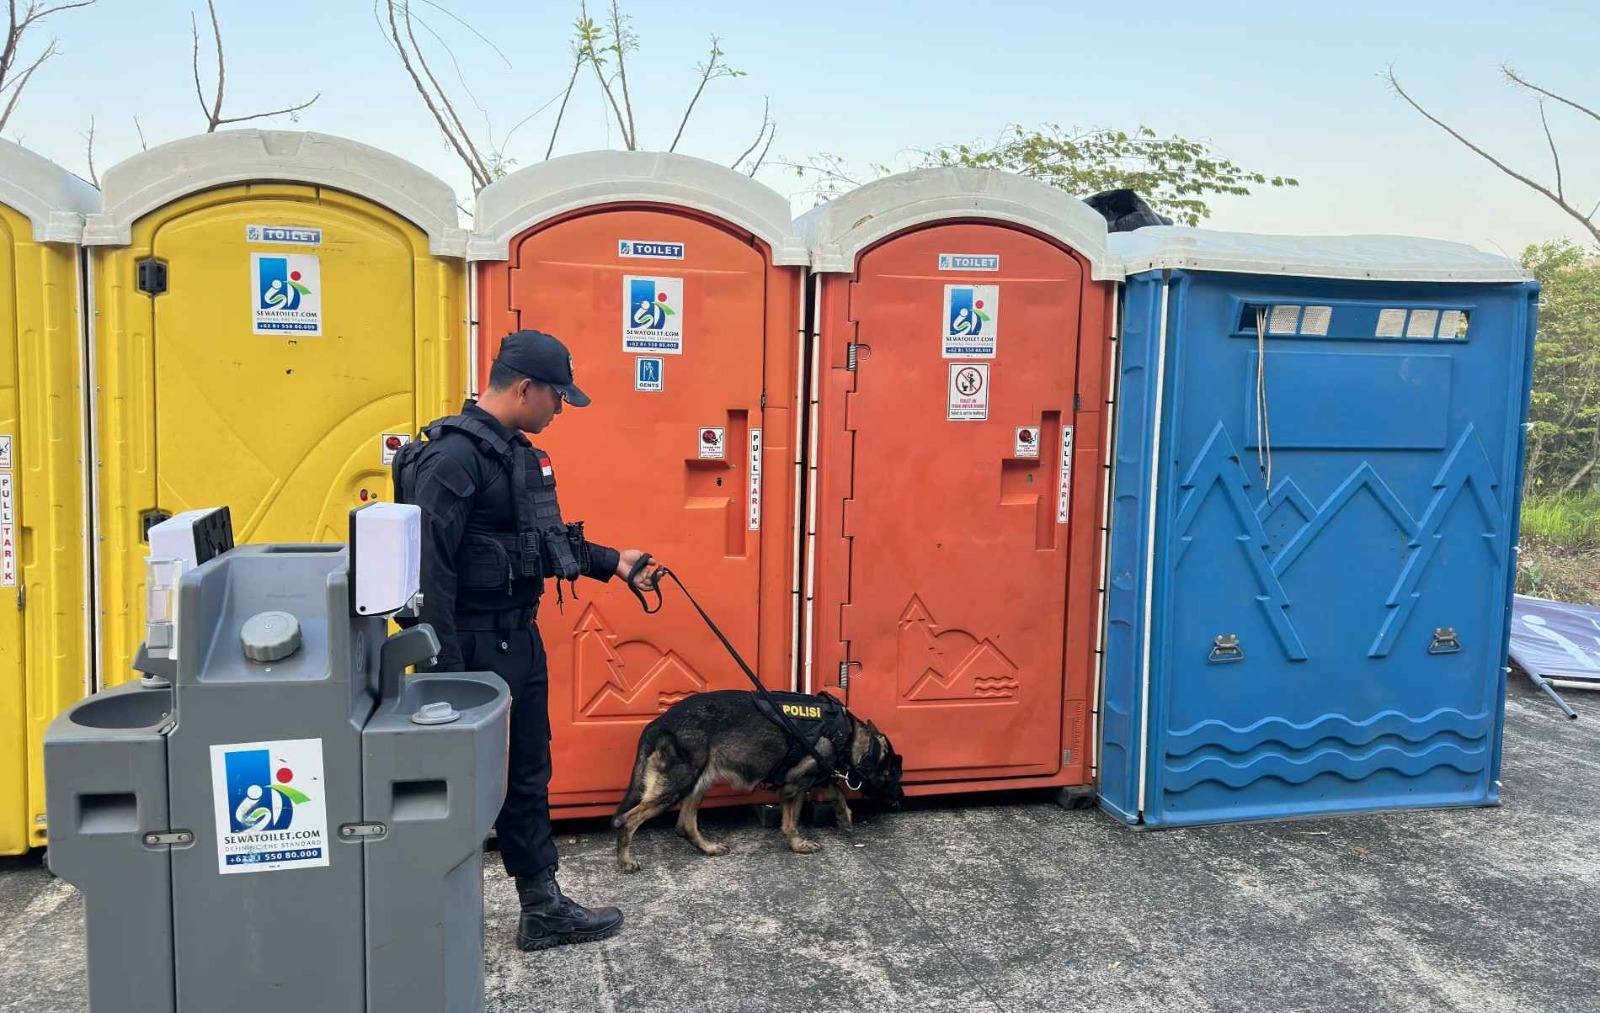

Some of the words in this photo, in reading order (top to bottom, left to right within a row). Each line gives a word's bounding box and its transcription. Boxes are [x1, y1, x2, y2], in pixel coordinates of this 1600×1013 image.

[266, 230, 317, 241] TOILET
[636, 245, 680, 255] TOILET
[954, 258, 996, 267] TOILET
[1063, 431, 1071, 467] PULL
[2, 479, 10, 520] PULL
[751, 478, 759, 525] TARIK
[1060, 472, 1069, 517] TARIK
[4, 527, 13, 580] TARIK
[782, 704, 821, 718] POLISI
[224, 829, 321, 845] SEWATOILET.COM
[281, 840, 322, 848] STANDARD
[264, 853, 282, 861] 550
[284, 849, 319, 858] 80.000
